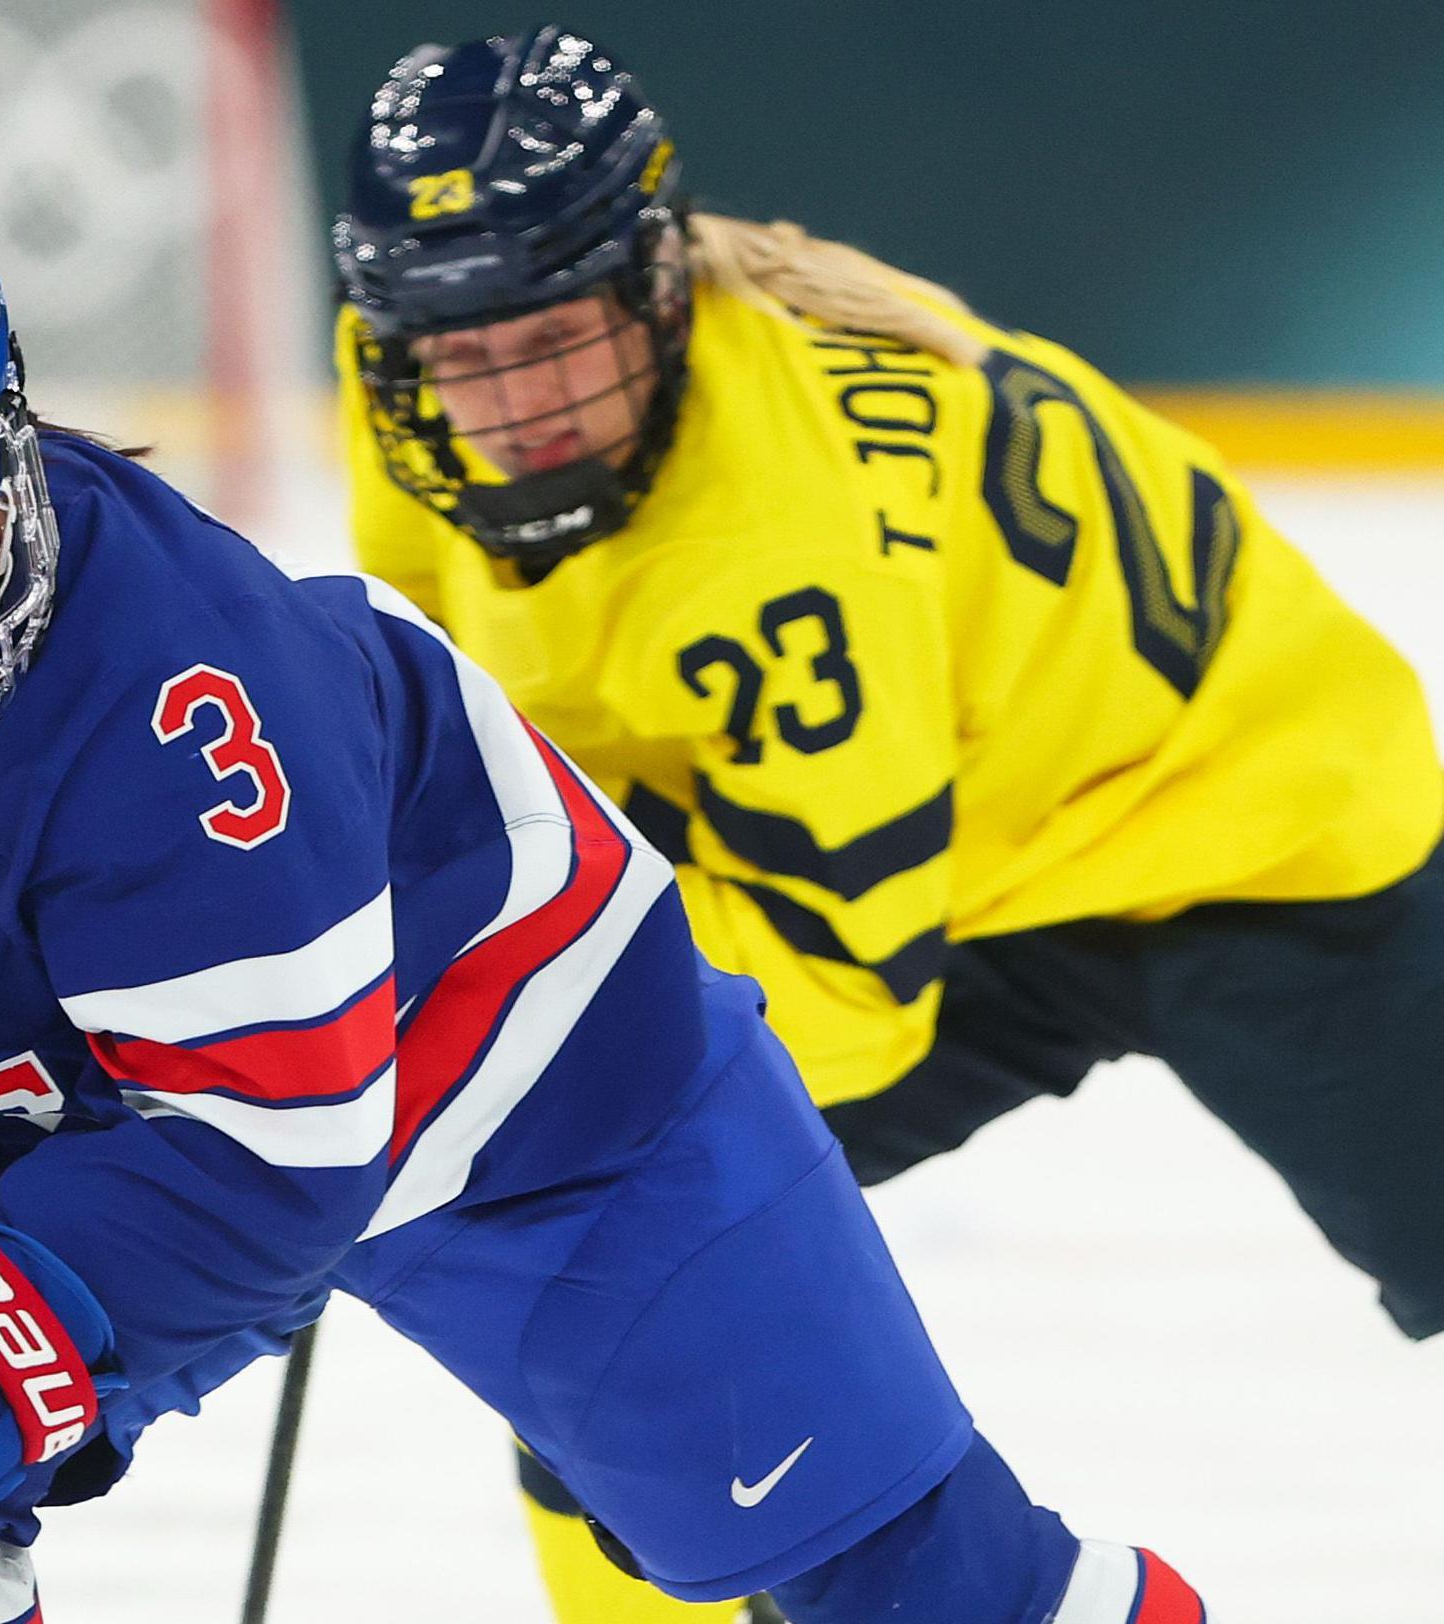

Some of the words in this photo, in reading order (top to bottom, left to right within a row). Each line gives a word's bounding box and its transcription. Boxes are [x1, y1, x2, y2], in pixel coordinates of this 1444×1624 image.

[811, 326, 941, 500] JOH
[874, 507, 939, 556] T
[150, 662, 292, 851] 3
[675, 585, 863, 766] 23
